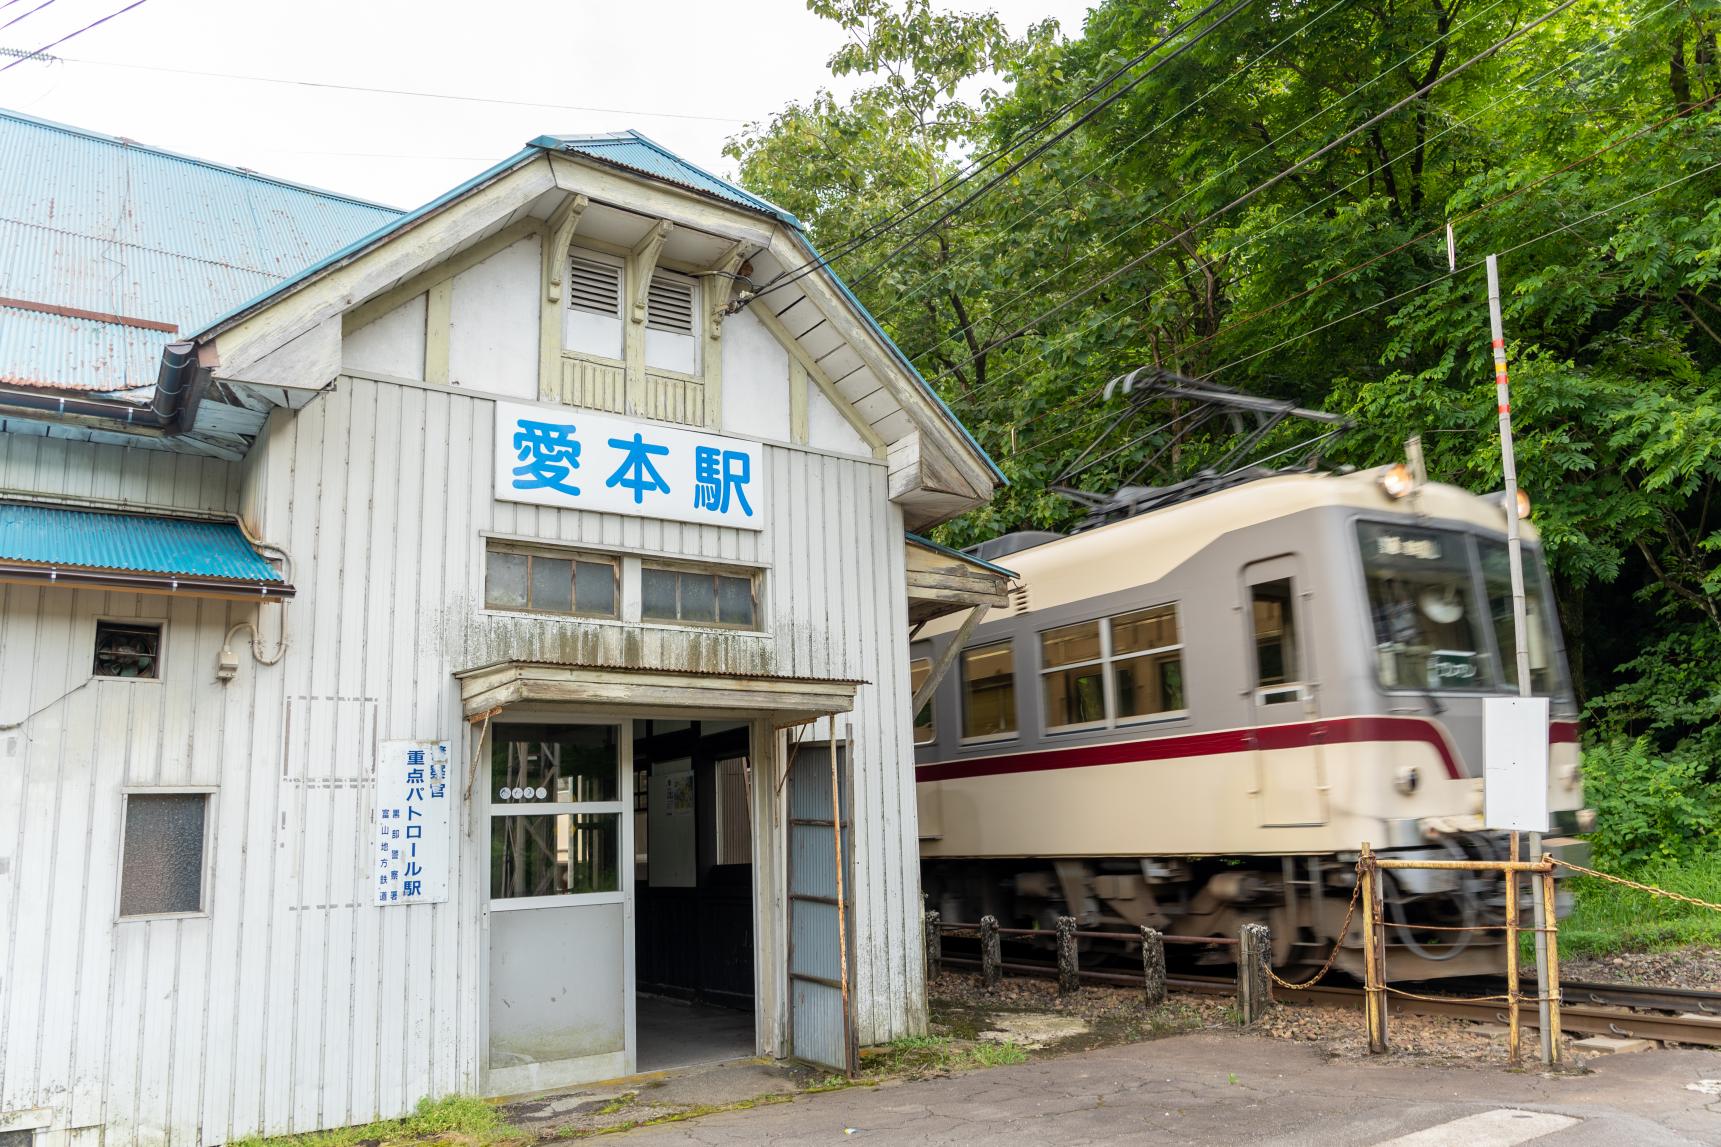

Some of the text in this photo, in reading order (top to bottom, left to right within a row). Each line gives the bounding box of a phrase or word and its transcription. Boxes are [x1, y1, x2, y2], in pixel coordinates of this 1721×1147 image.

[511, 418, 754, 517] 愛本駅
[379, 808, 390, 902] 富山地方鉄道
[390, 808, 400, 901] 黒部警察署
[402, 749, 425, 898] 重点パトロール駅
